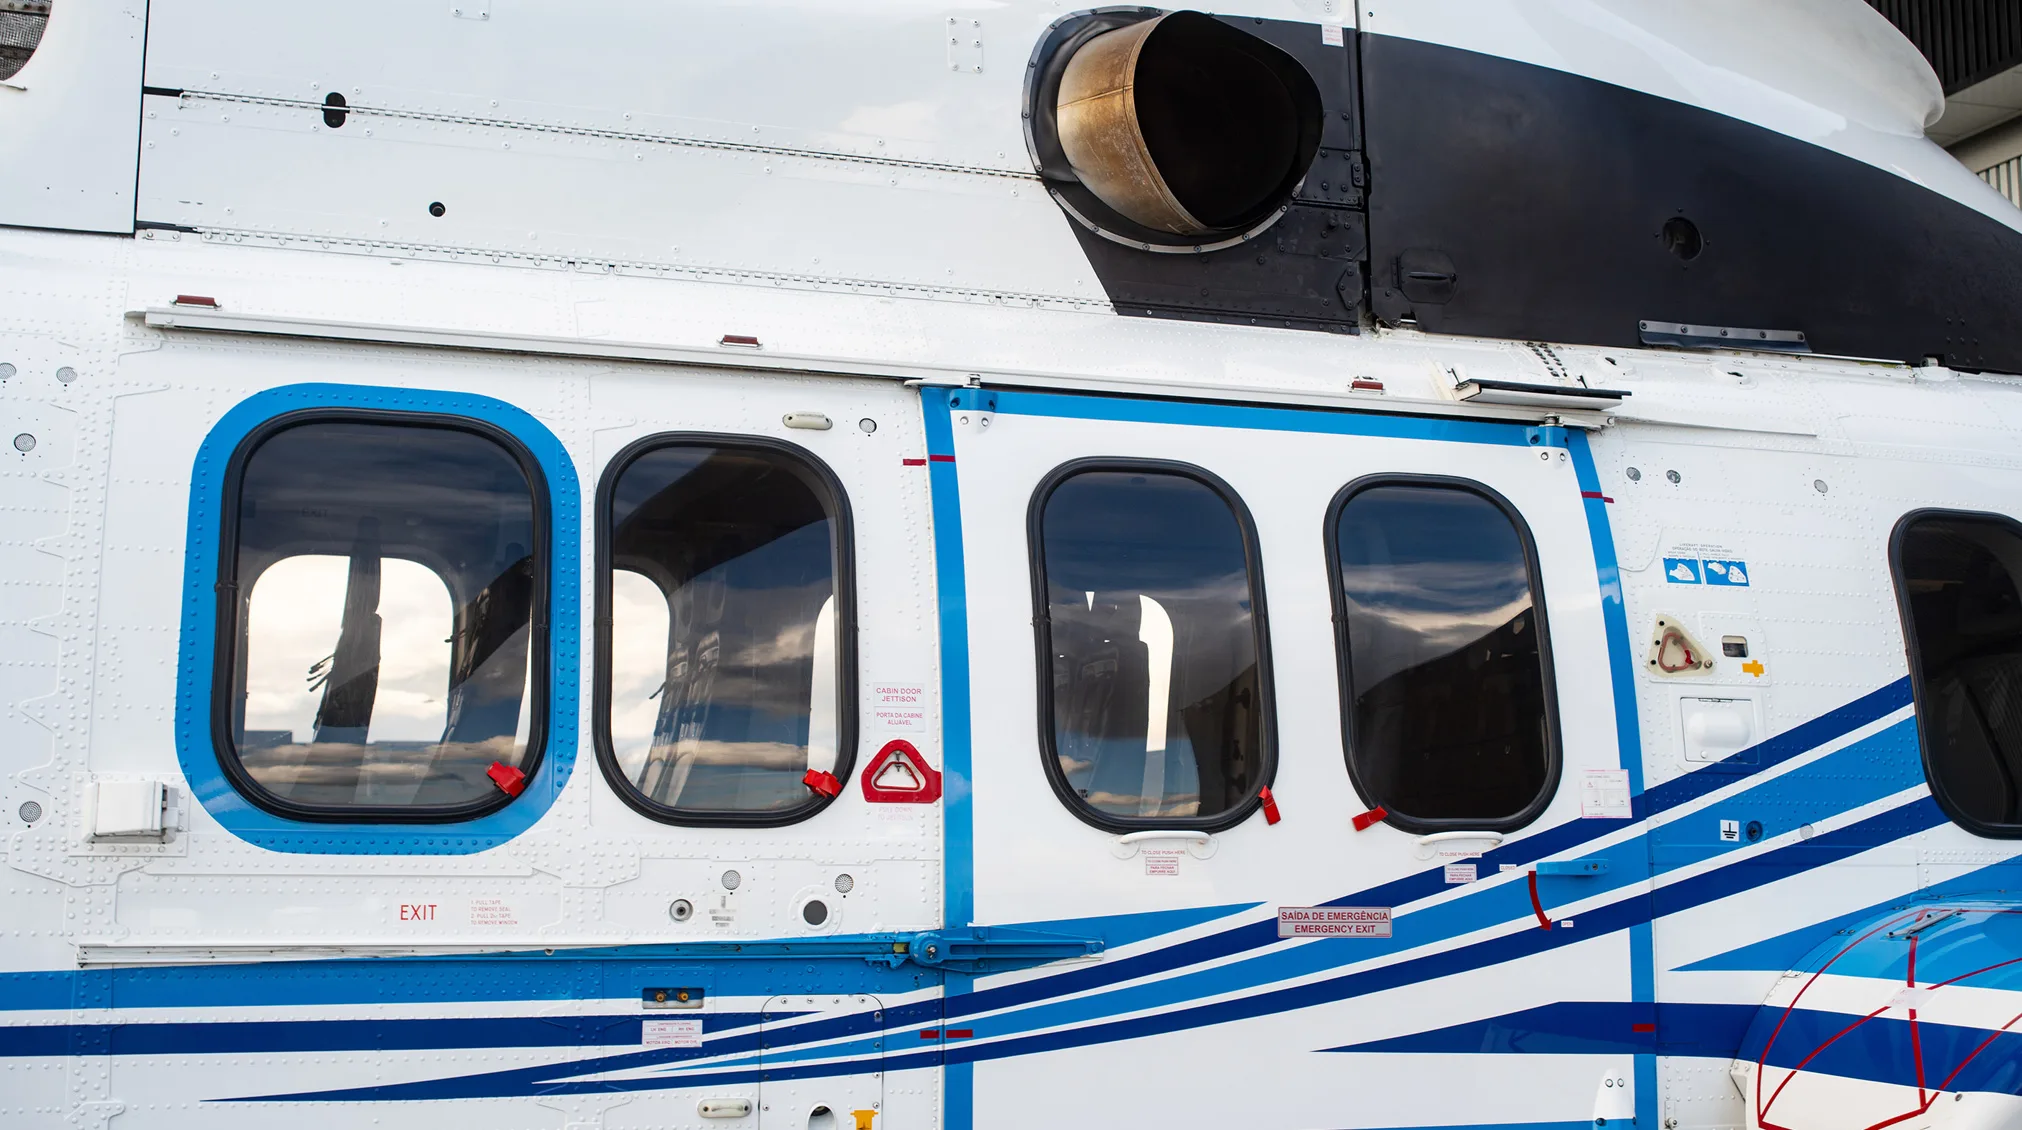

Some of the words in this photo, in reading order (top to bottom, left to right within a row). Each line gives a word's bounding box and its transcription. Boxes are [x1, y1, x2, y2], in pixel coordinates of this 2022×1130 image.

[400, 904, 437, 920] EXIT
[1282, 910, 1309, 920] SAÍDA
[1312, 912, 1324, 920] DE
[1328, 910, 1388, 920] EMERGÊNCIA
[1295, 925, 1353, 933] EMERGENCY
[1356, 925, 1376, 933] EXIT
